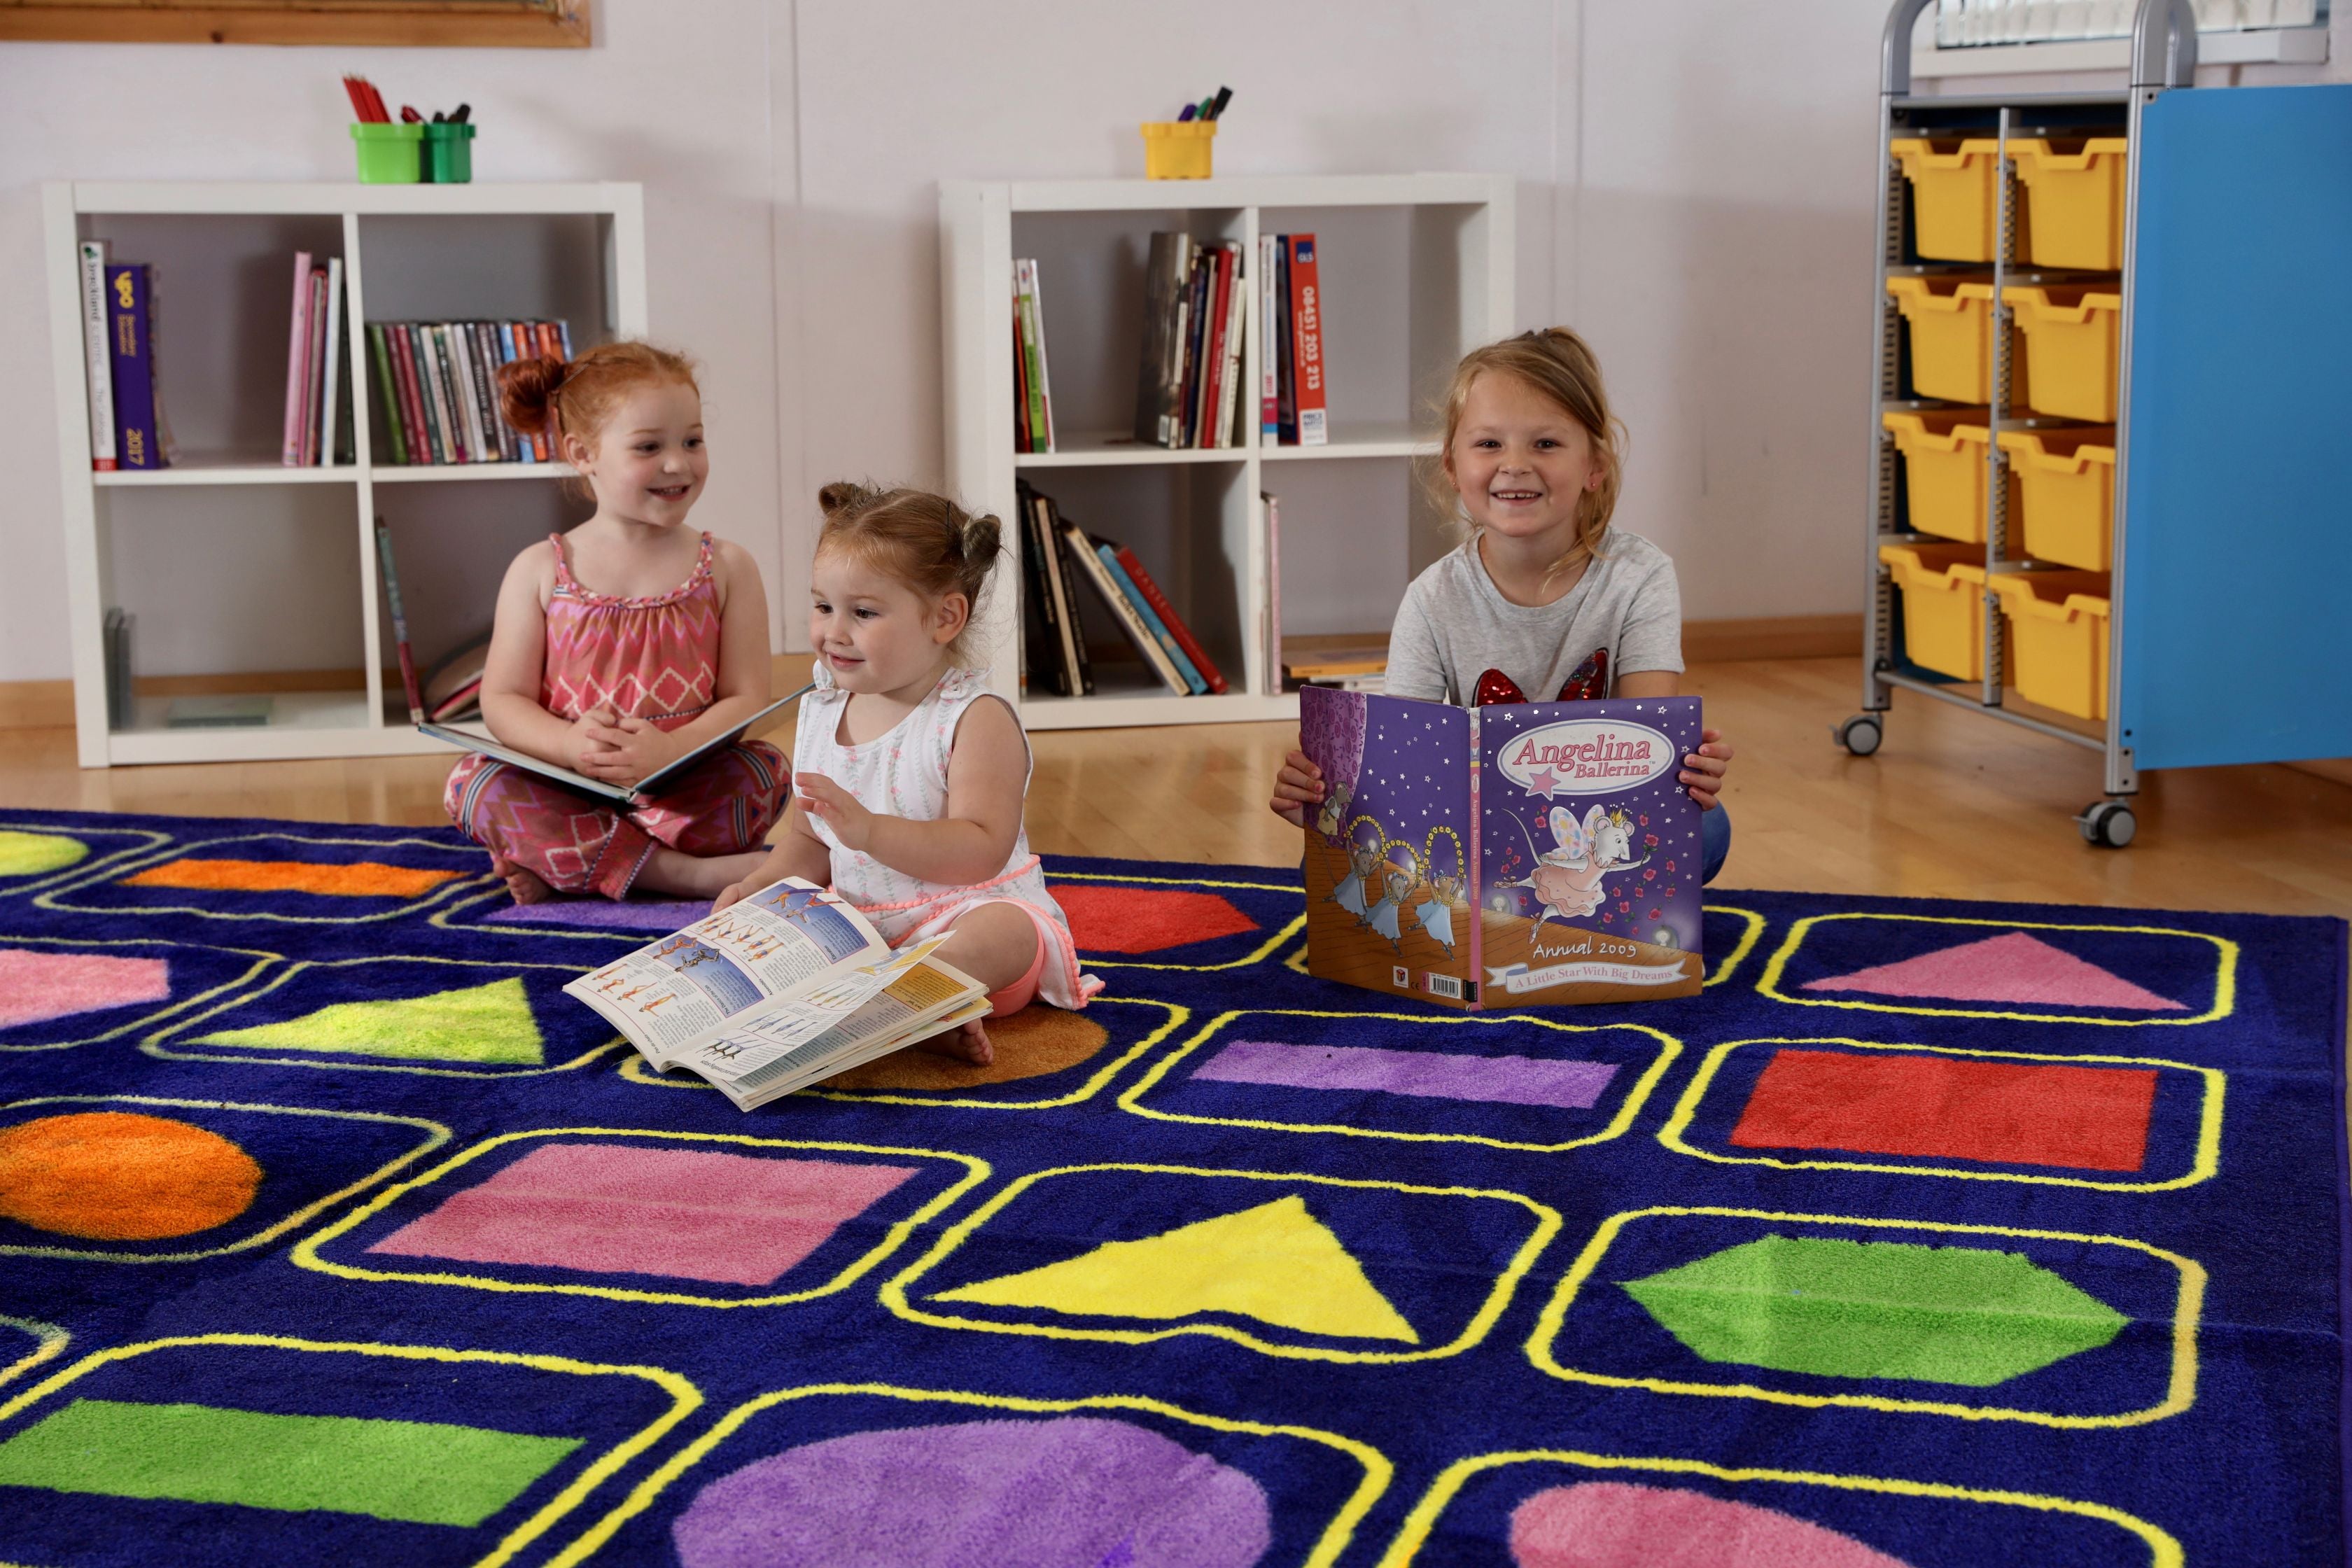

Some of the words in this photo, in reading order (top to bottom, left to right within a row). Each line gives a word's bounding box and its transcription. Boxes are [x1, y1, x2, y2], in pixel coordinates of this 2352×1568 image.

[114, 270, 135, 309] ypo
[1302, 286, 1317, 330] 08451
[1305, 333, 1319, 361] 203
[1307, 365, 1322, 391] 213
[126, 428, 144, 466] 2017
[1512, 734, 1651, 772] Angelina
[1574, 761, 1651, 778] Ballerina
[1532, 936, 1592, 958] Annual
[1599, 942, 1638, 958] 2009
[1516, 980, 1525, 988] A
[1527, 972, 1557, 986] Little
[1558, 968, 1581, 979] Star
[1583, 966, 1608, 977] With
[1611, 968, 1629, 982] Big
[1631, 969, 1673, 981] Dreams
